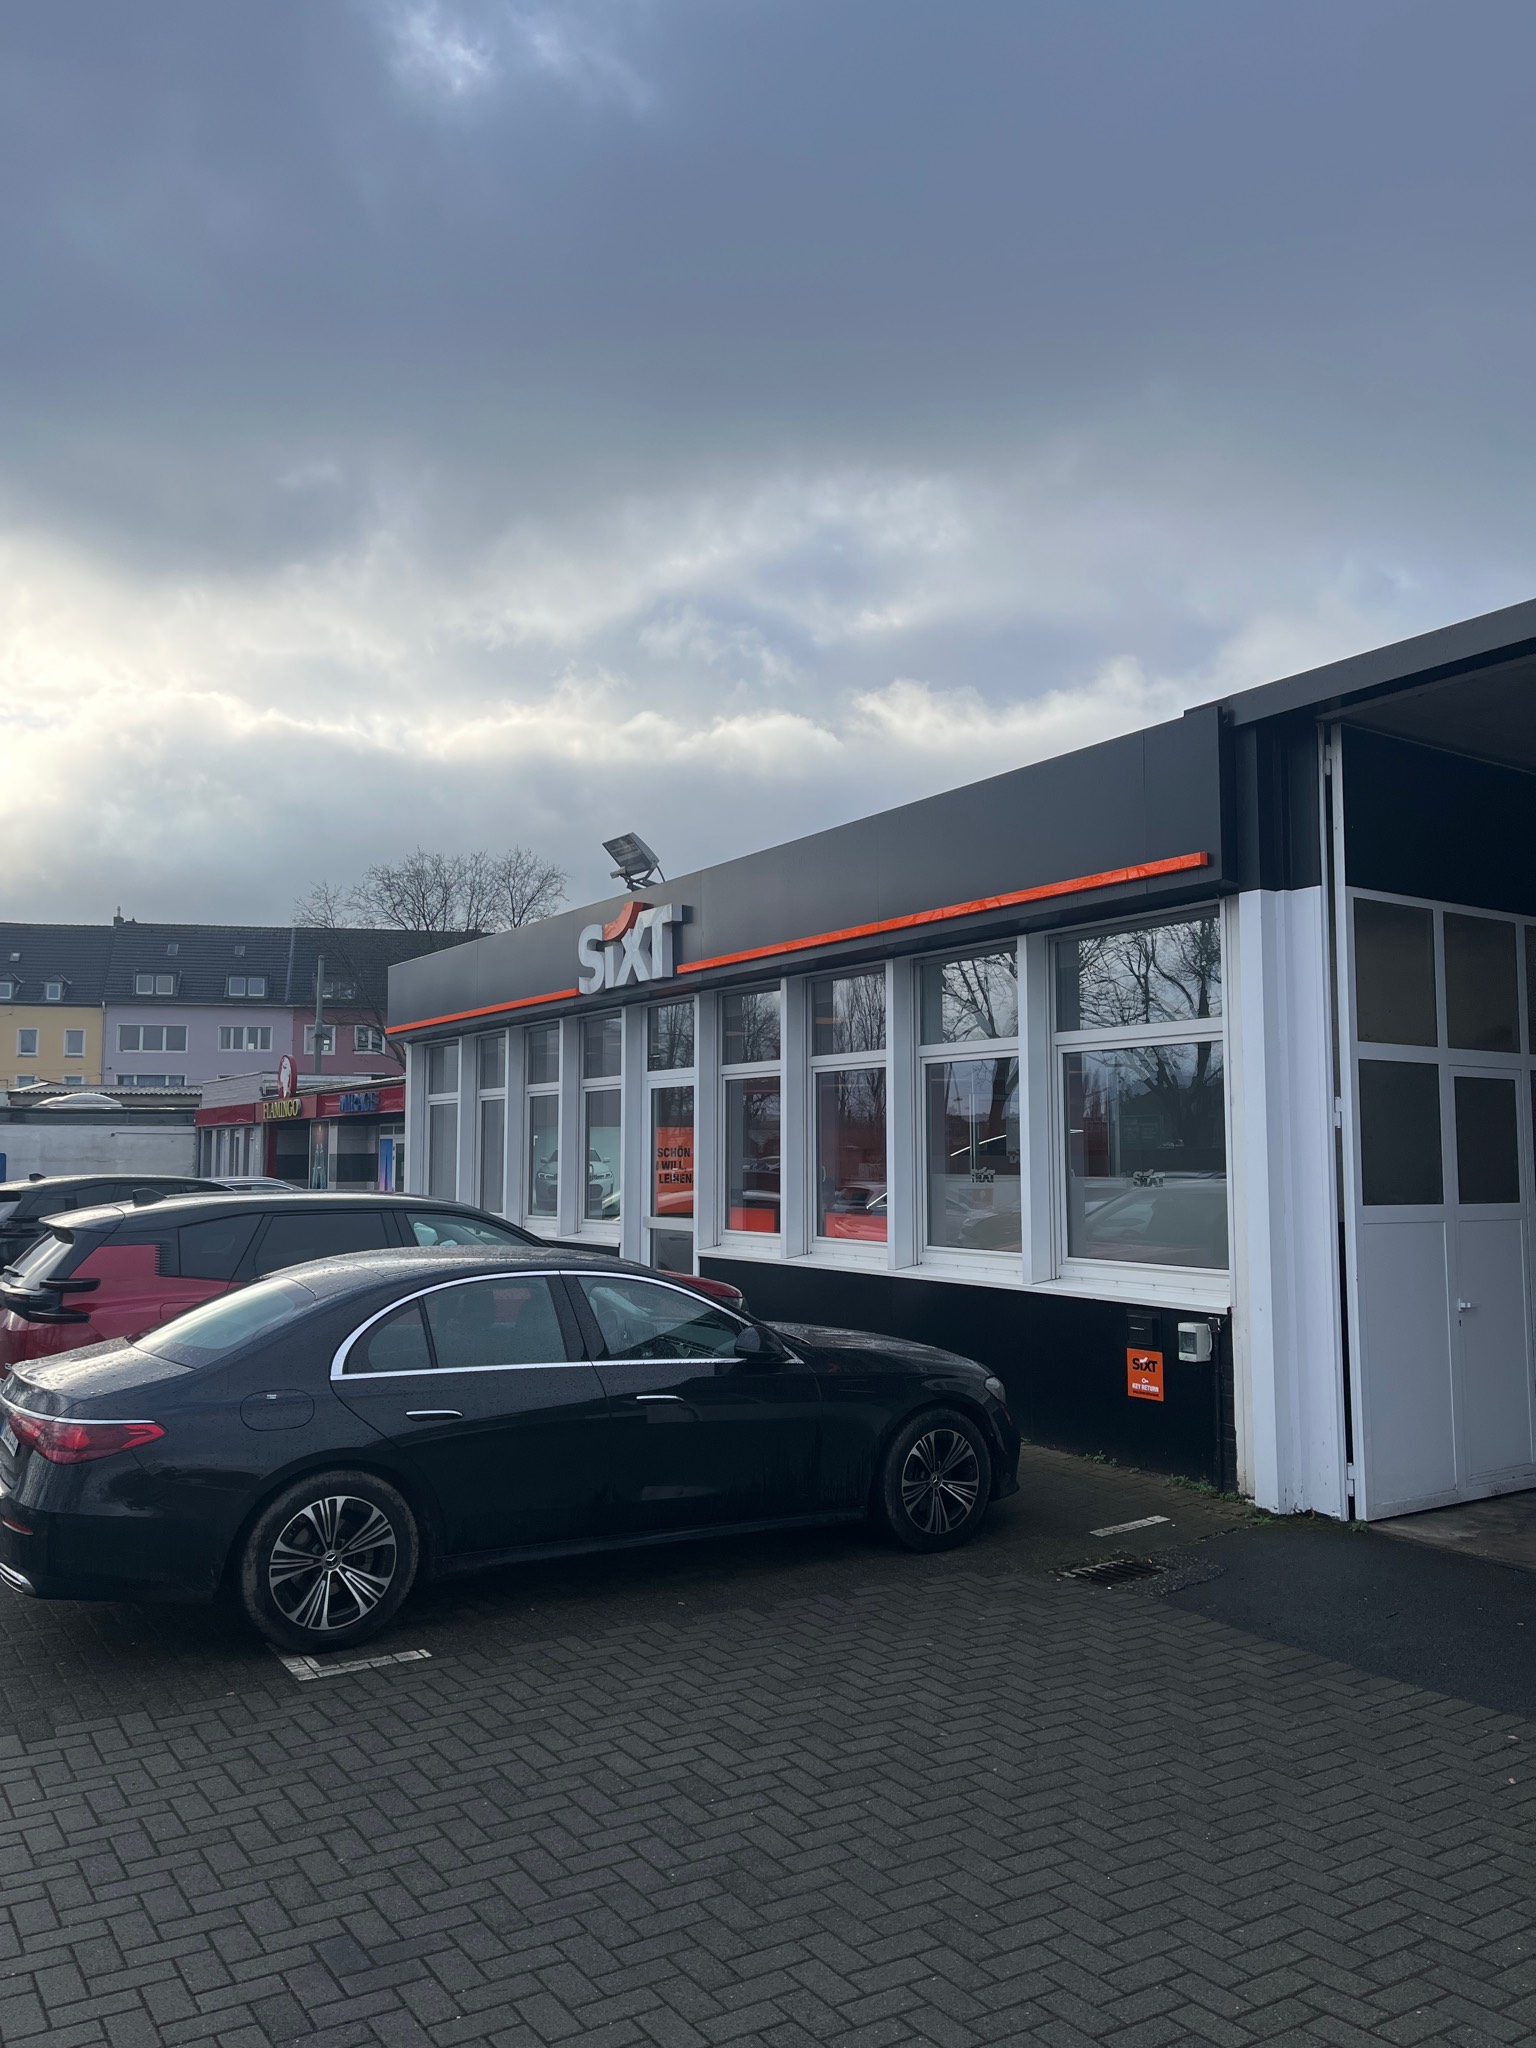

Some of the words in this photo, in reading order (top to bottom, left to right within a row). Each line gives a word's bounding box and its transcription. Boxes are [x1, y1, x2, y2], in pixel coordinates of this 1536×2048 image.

[263, 1099, 301, 1120] FLAMINGO
[657, 1145, 691, 1158] SCHÖN
[661, 1160, 687, 1172] WILL,
